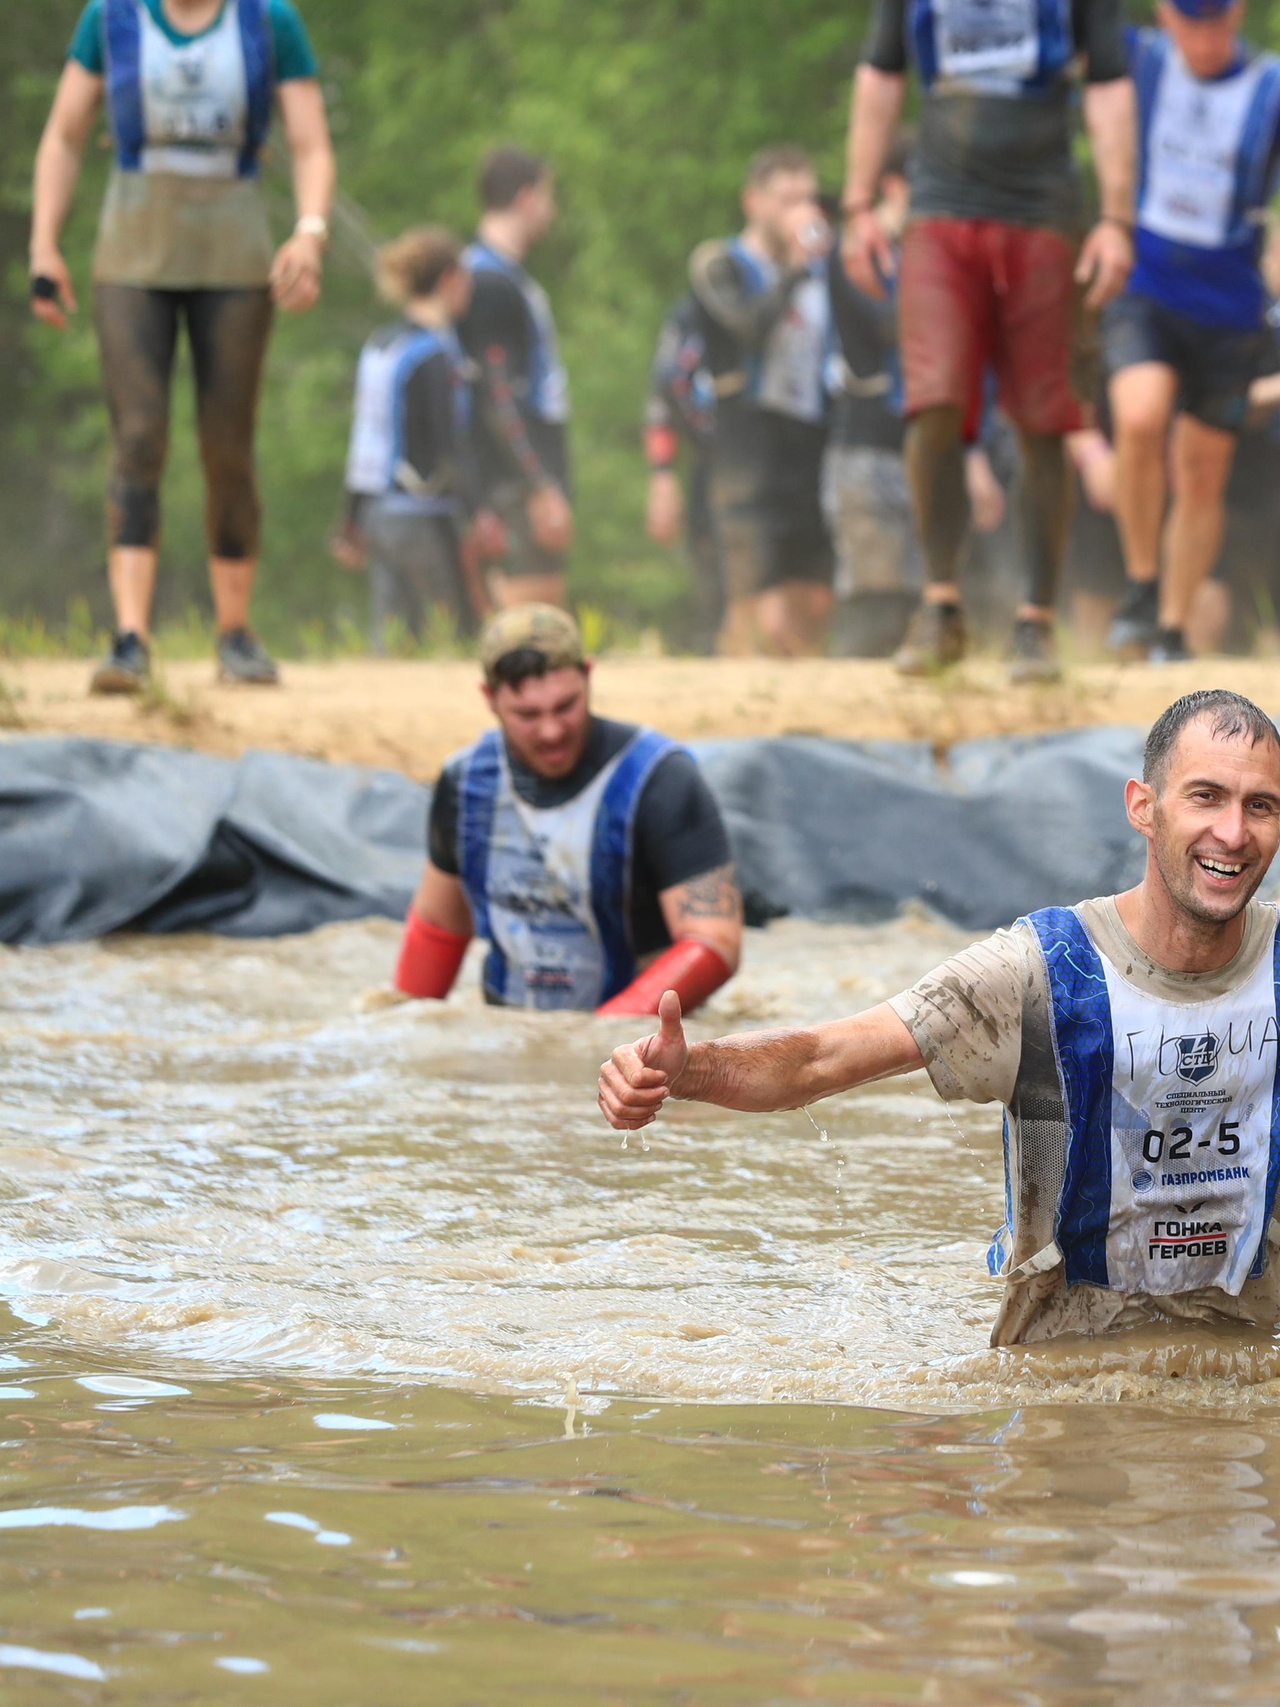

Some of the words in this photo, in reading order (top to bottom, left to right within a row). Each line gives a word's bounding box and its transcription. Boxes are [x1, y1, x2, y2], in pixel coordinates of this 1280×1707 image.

[1165, 1088, 1227, 1100] СПЕЦИАЛЬНЫЙ
[1154, 1096, 1233, 1109] ТЕХНОЛОГИЧЕСКИЙ
[1180, 1107, 1207, 1115] ЦЕНТР
[1142, 1122, 1241, 1163] 02-5
[1161, 1167, 1250, 1186] ГАЗПРОМБАНК
[1154, 1221, 1223, 1237] ГОНКА
[1148, 1240, 1228, 1260] ГЕРОЕВ
